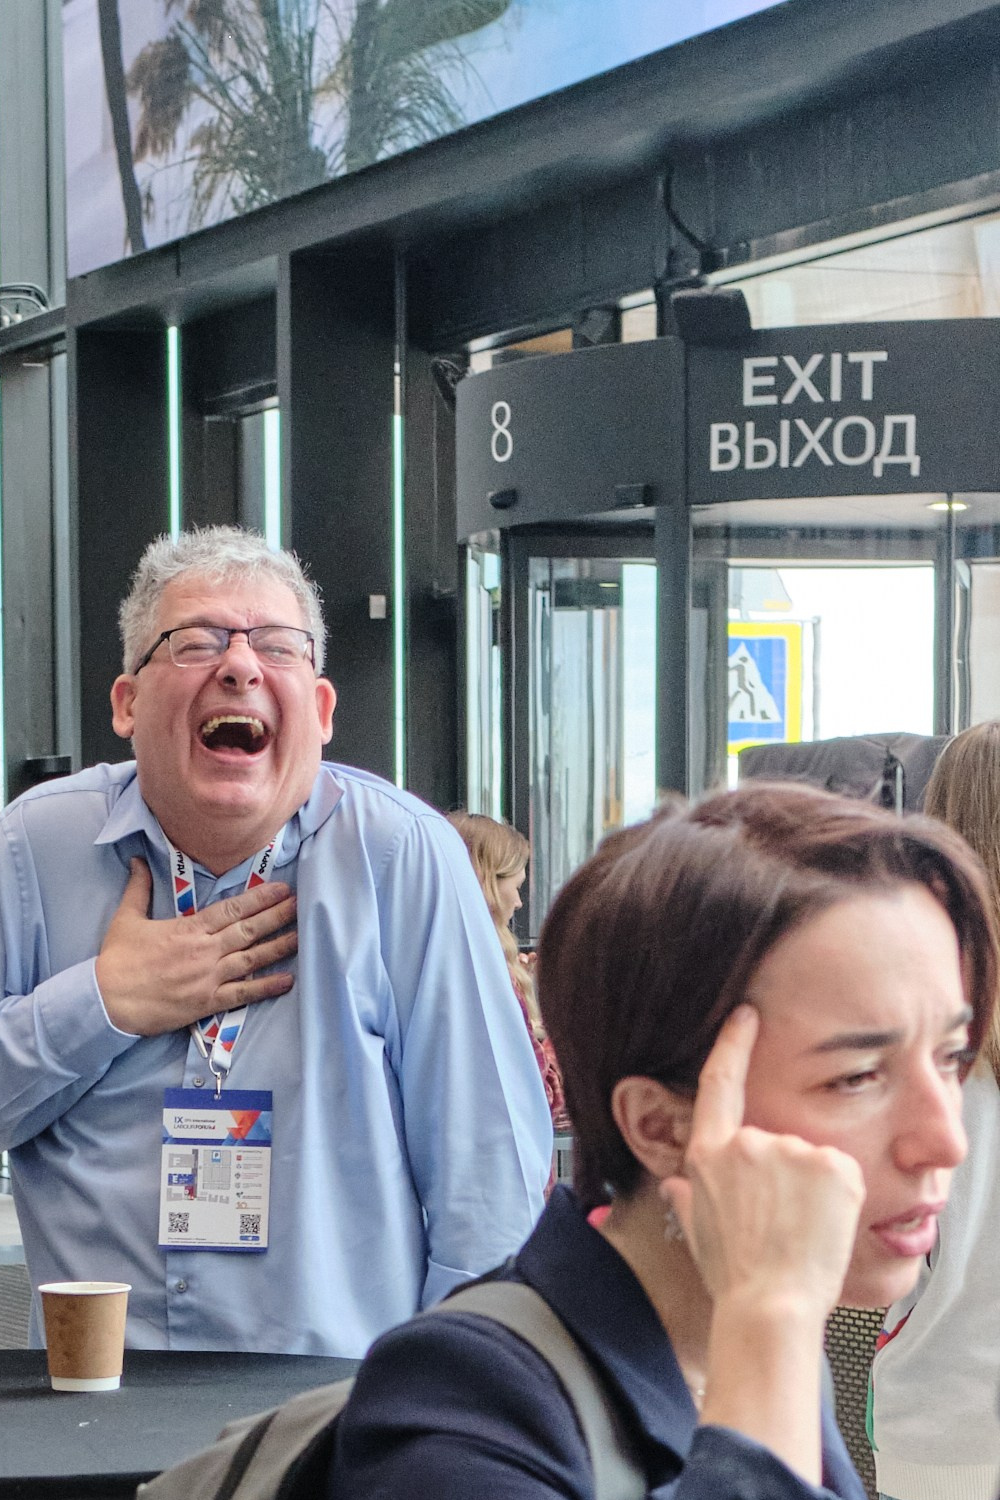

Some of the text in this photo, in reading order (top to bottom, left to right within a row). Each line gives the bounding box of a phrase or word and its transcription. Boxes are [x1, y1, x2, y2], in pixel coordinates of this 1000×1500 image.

[742, 350, 888, 406] EXIT
[490, 400, 514, 463] 8
[709, 413, 921, 478] ВЫХОД
[174, 1116, 184, 1124] IX
